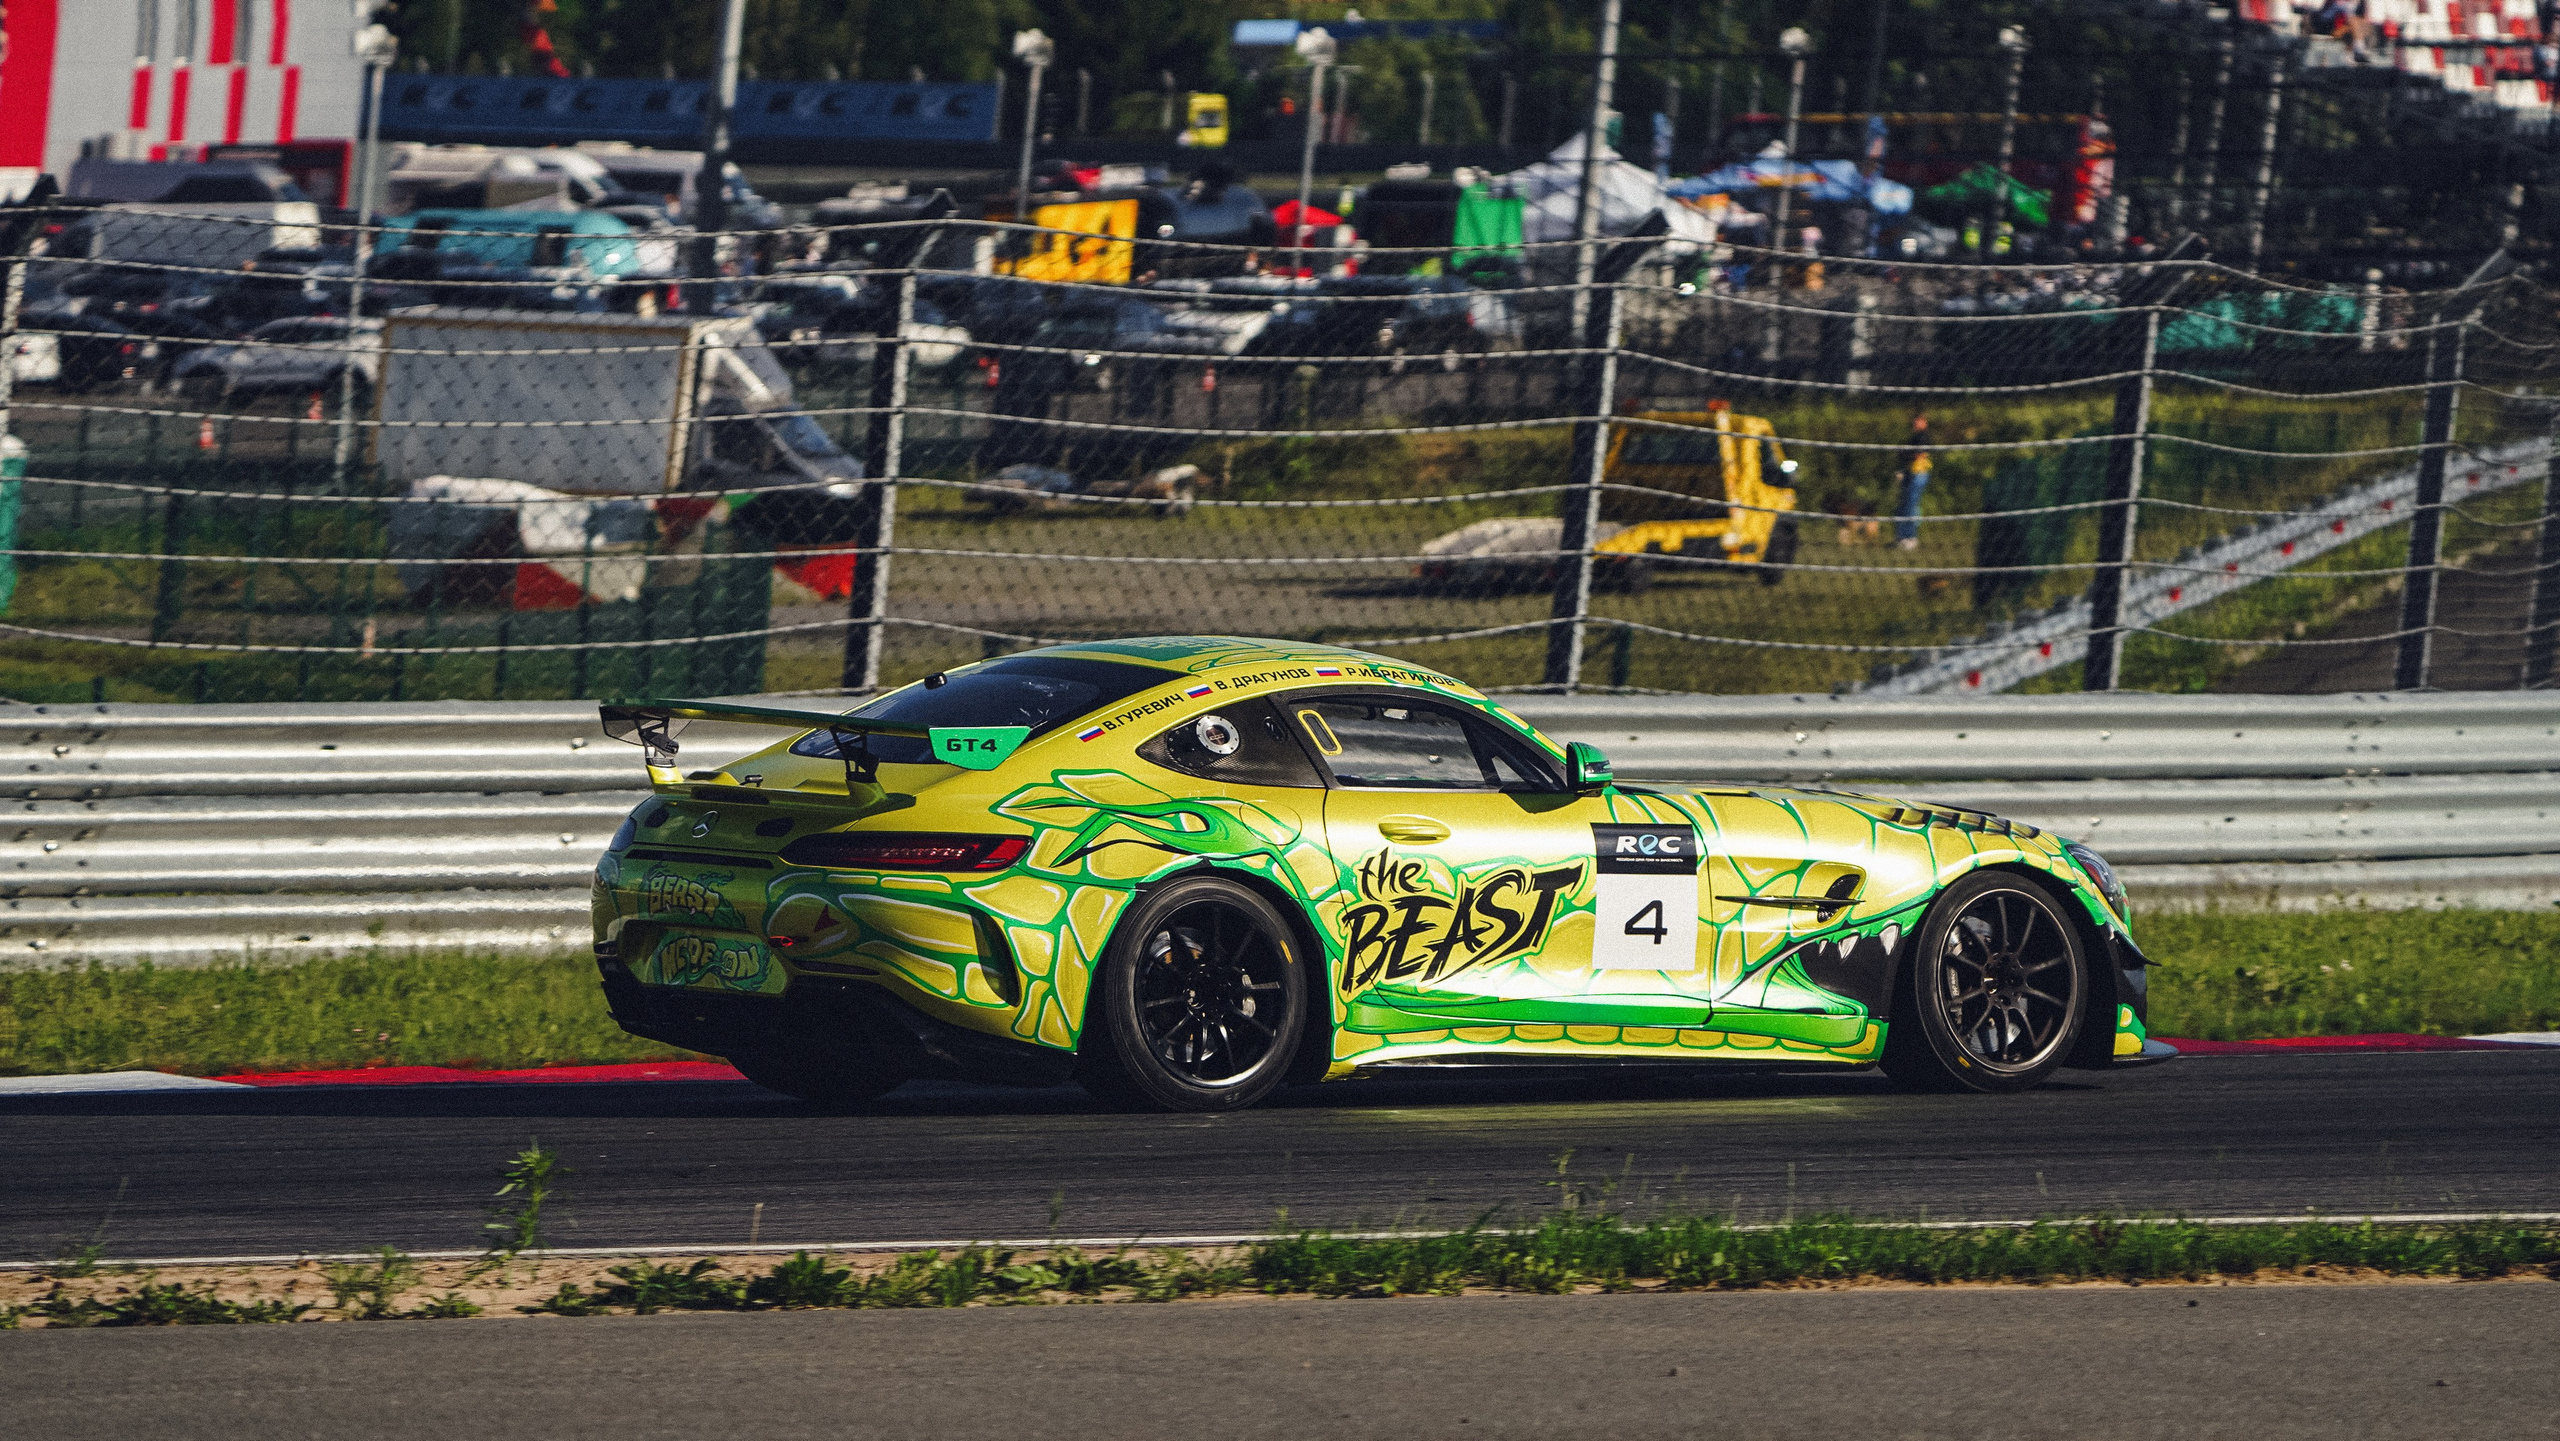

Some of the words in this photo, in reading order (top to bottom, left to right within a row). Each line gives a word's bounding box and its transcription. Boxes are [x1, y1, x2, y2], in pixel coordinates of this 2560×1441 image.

[1345, 667, 1456, 687] Р.ИБРАГИМОВ
[1102, 693, 1185, 731] В.ГУРЕВИЧ
[946, 738, 998, 752] GT4
[1358, 846, 1429, 901] the
[649, 875, 721, 921] BEAST
[1342, 863, 1584, 993] BEAST
[1624, 899, 1668, 945] 4
[720, 944, 761, 979] ON
